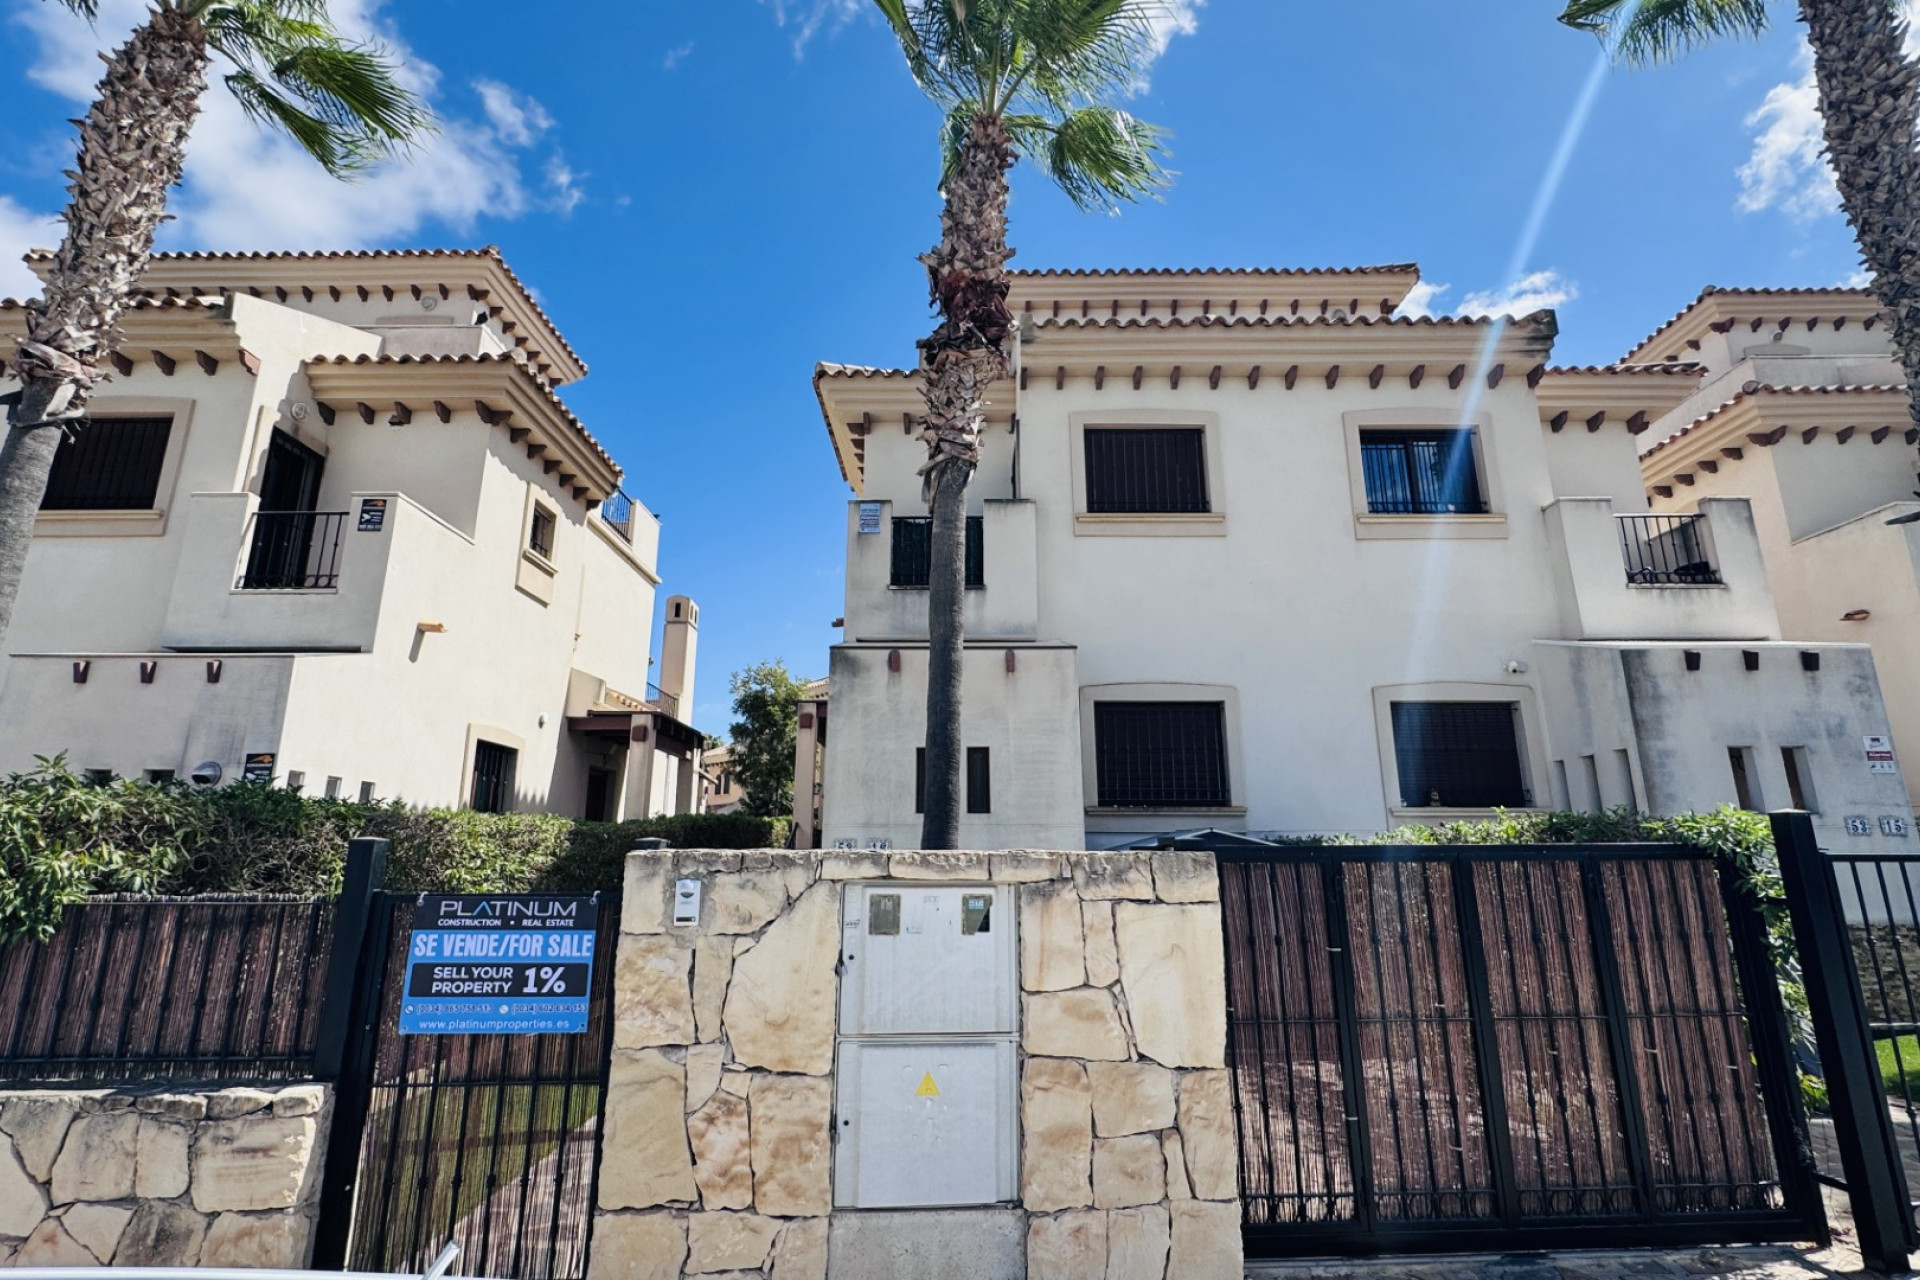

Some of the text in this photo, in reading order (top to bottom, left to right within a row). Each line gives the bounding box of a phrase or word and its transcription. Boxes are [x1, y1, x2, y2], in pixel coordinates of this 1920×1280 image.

[1851, 820, 1867, 833] 53
[1886, 819, 1902, 833] 15
[439, 900, 577, 917] PLATINUM
[438, 918, 575, 927] CONSTRUCTION REAL ESTATE
[414, 933, 593, 958] SE VENDE/FOR SALE
[433, 966, 514, 979] SELL YOUR
[522, 966, 567, 994] 1%
[431, 981, 513, 994] PROPERTY
[419, 1018, 570, 1031] www.platinumproperties.es
